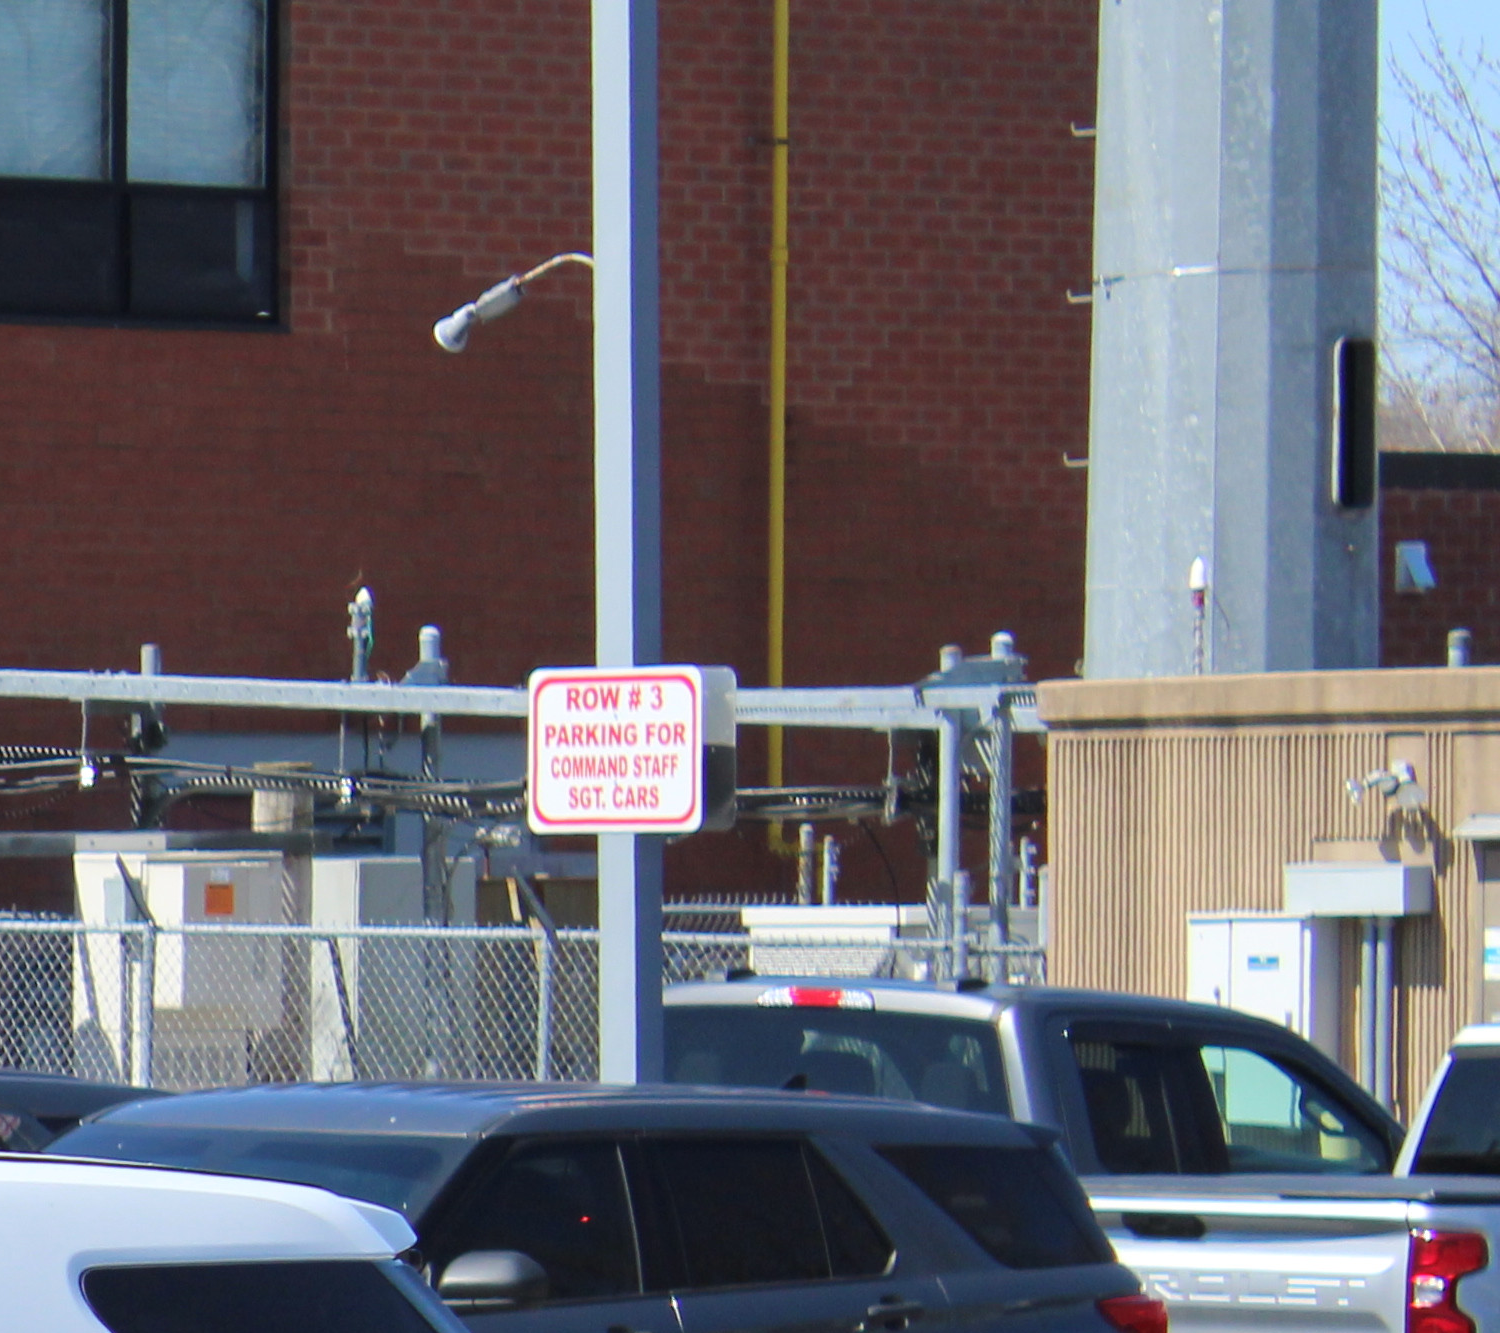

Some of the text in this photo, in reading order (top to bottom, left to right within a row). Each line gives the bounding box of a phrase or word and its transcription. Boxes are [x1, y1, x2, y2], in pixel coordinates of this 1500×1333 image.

[566, 685, 663, 711] ROW # 3
[545, 723, 686, 747] PARKING FOR
[551, 753, 678, 779] COMMAND STAFF
[568, 785, 660, 808] SGT. CARS
